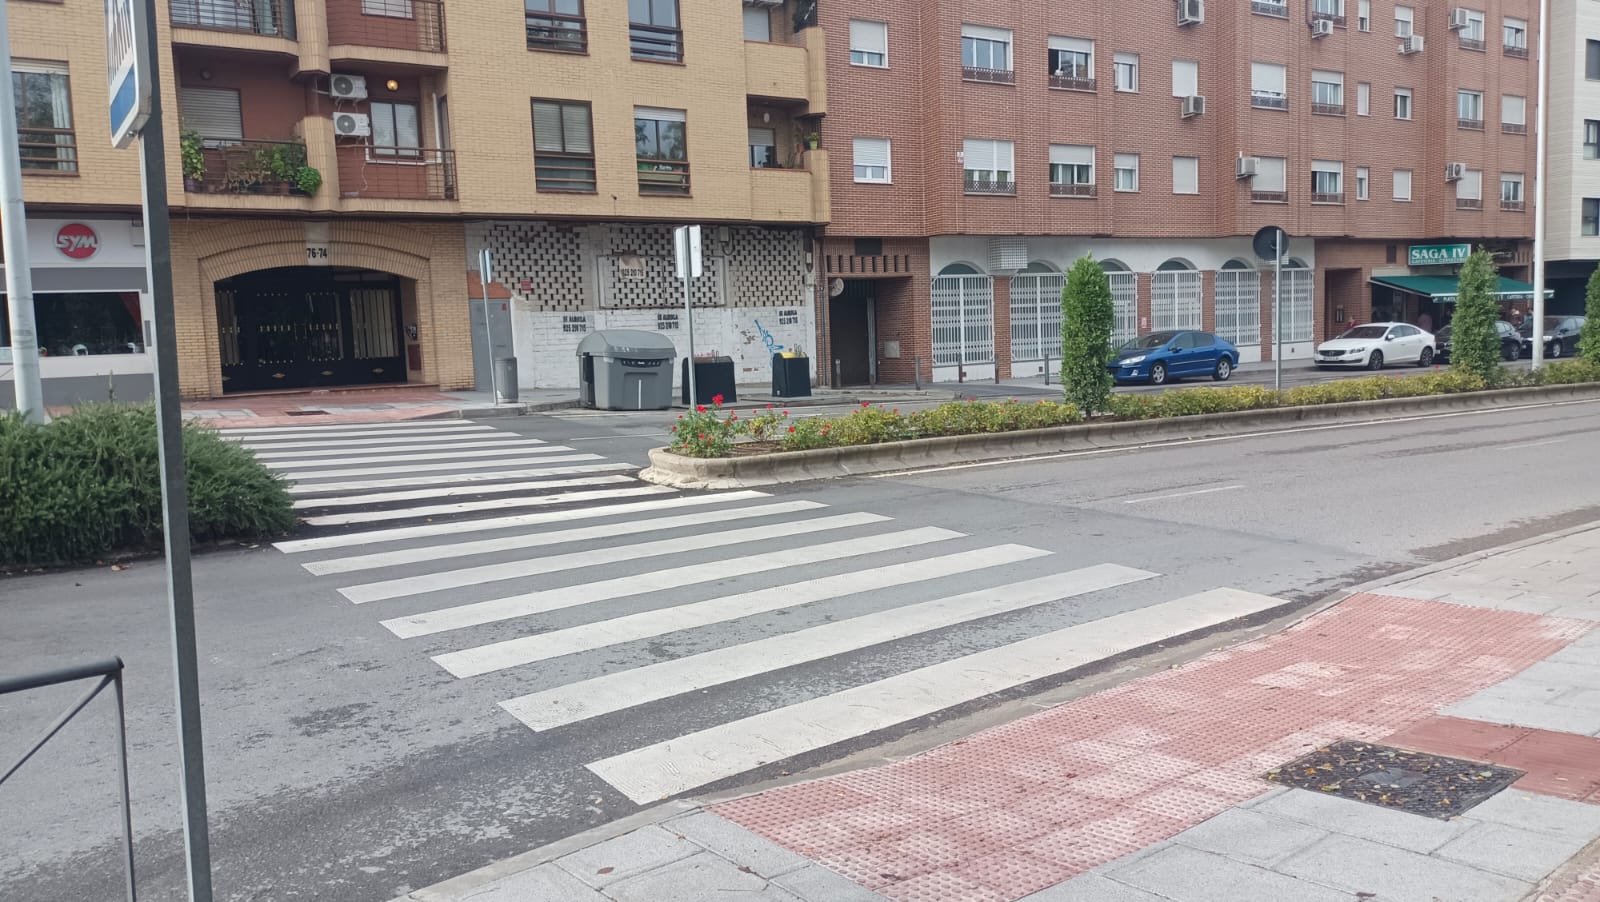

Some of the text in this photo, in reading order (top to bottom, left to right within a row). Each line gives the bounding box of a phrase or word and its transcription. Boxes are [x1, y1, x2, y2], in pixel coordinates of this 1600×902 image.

[56, 234, 97, 252] SYM
[1411, 248, 1466, 259] SAGA IV
